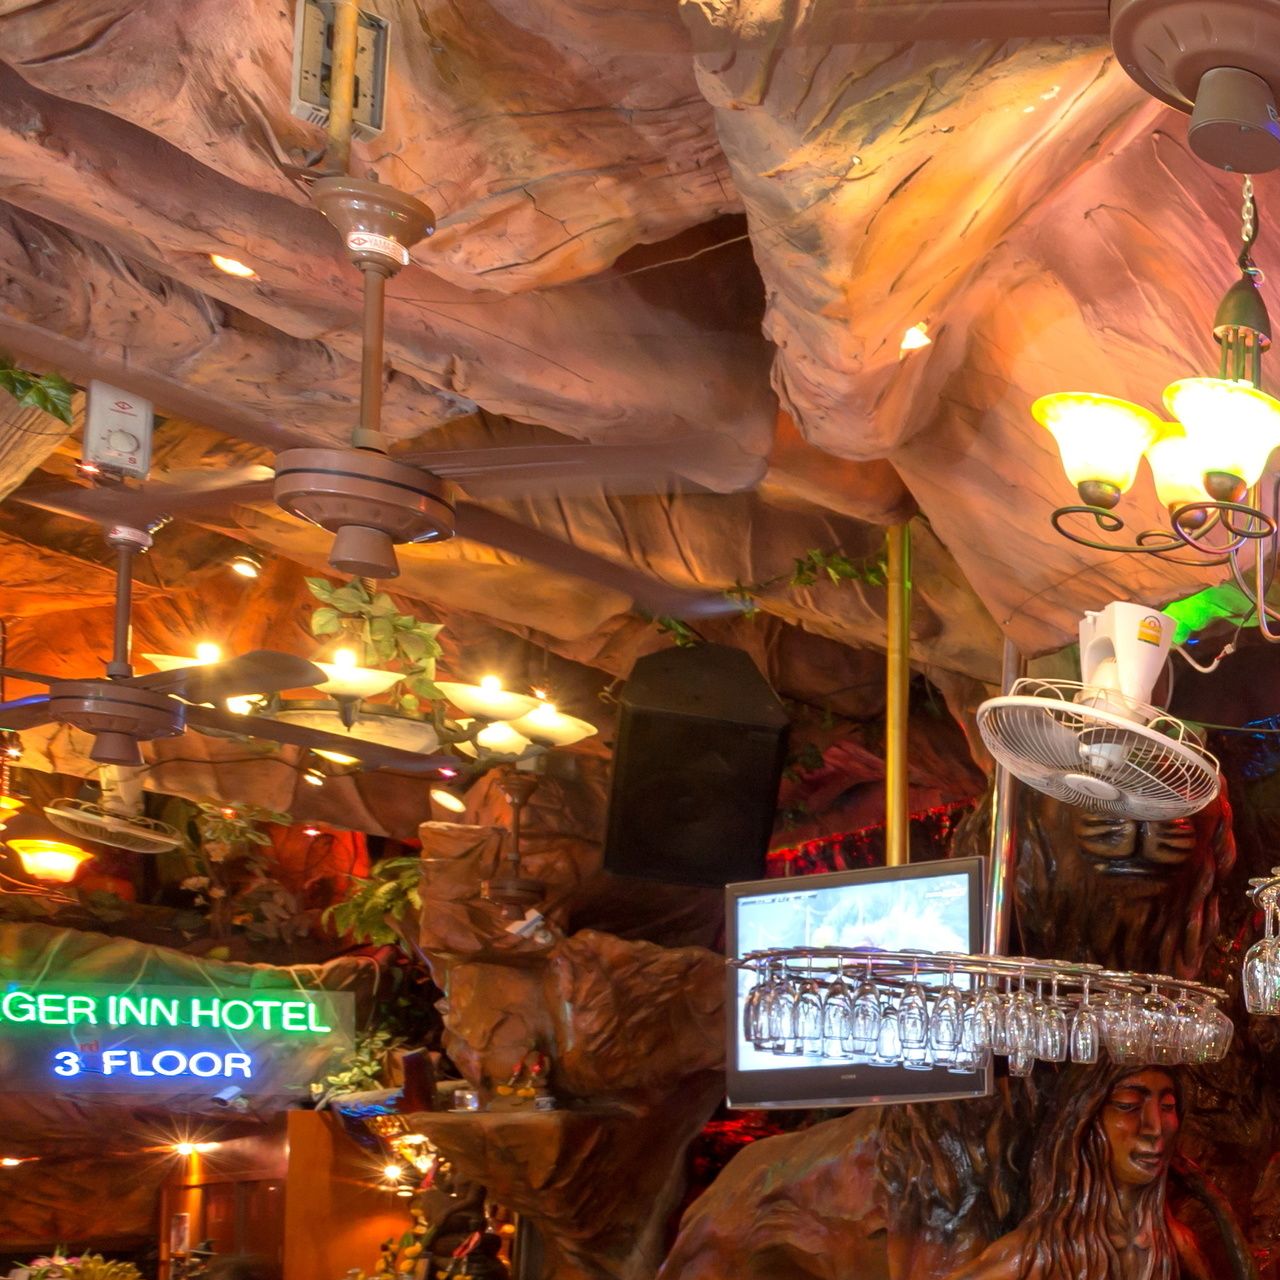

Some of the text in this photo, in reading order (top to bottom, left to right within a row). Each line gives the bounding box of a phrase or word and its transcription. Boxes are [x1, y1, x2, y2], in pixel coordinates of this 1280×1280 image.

[108, 996, 179, 1026] INN
[191, 998, 332, 1033] HOTEL
[54, 1051, 80, 1077] 3
[102, 1050, 252, 1079] FLOOR
